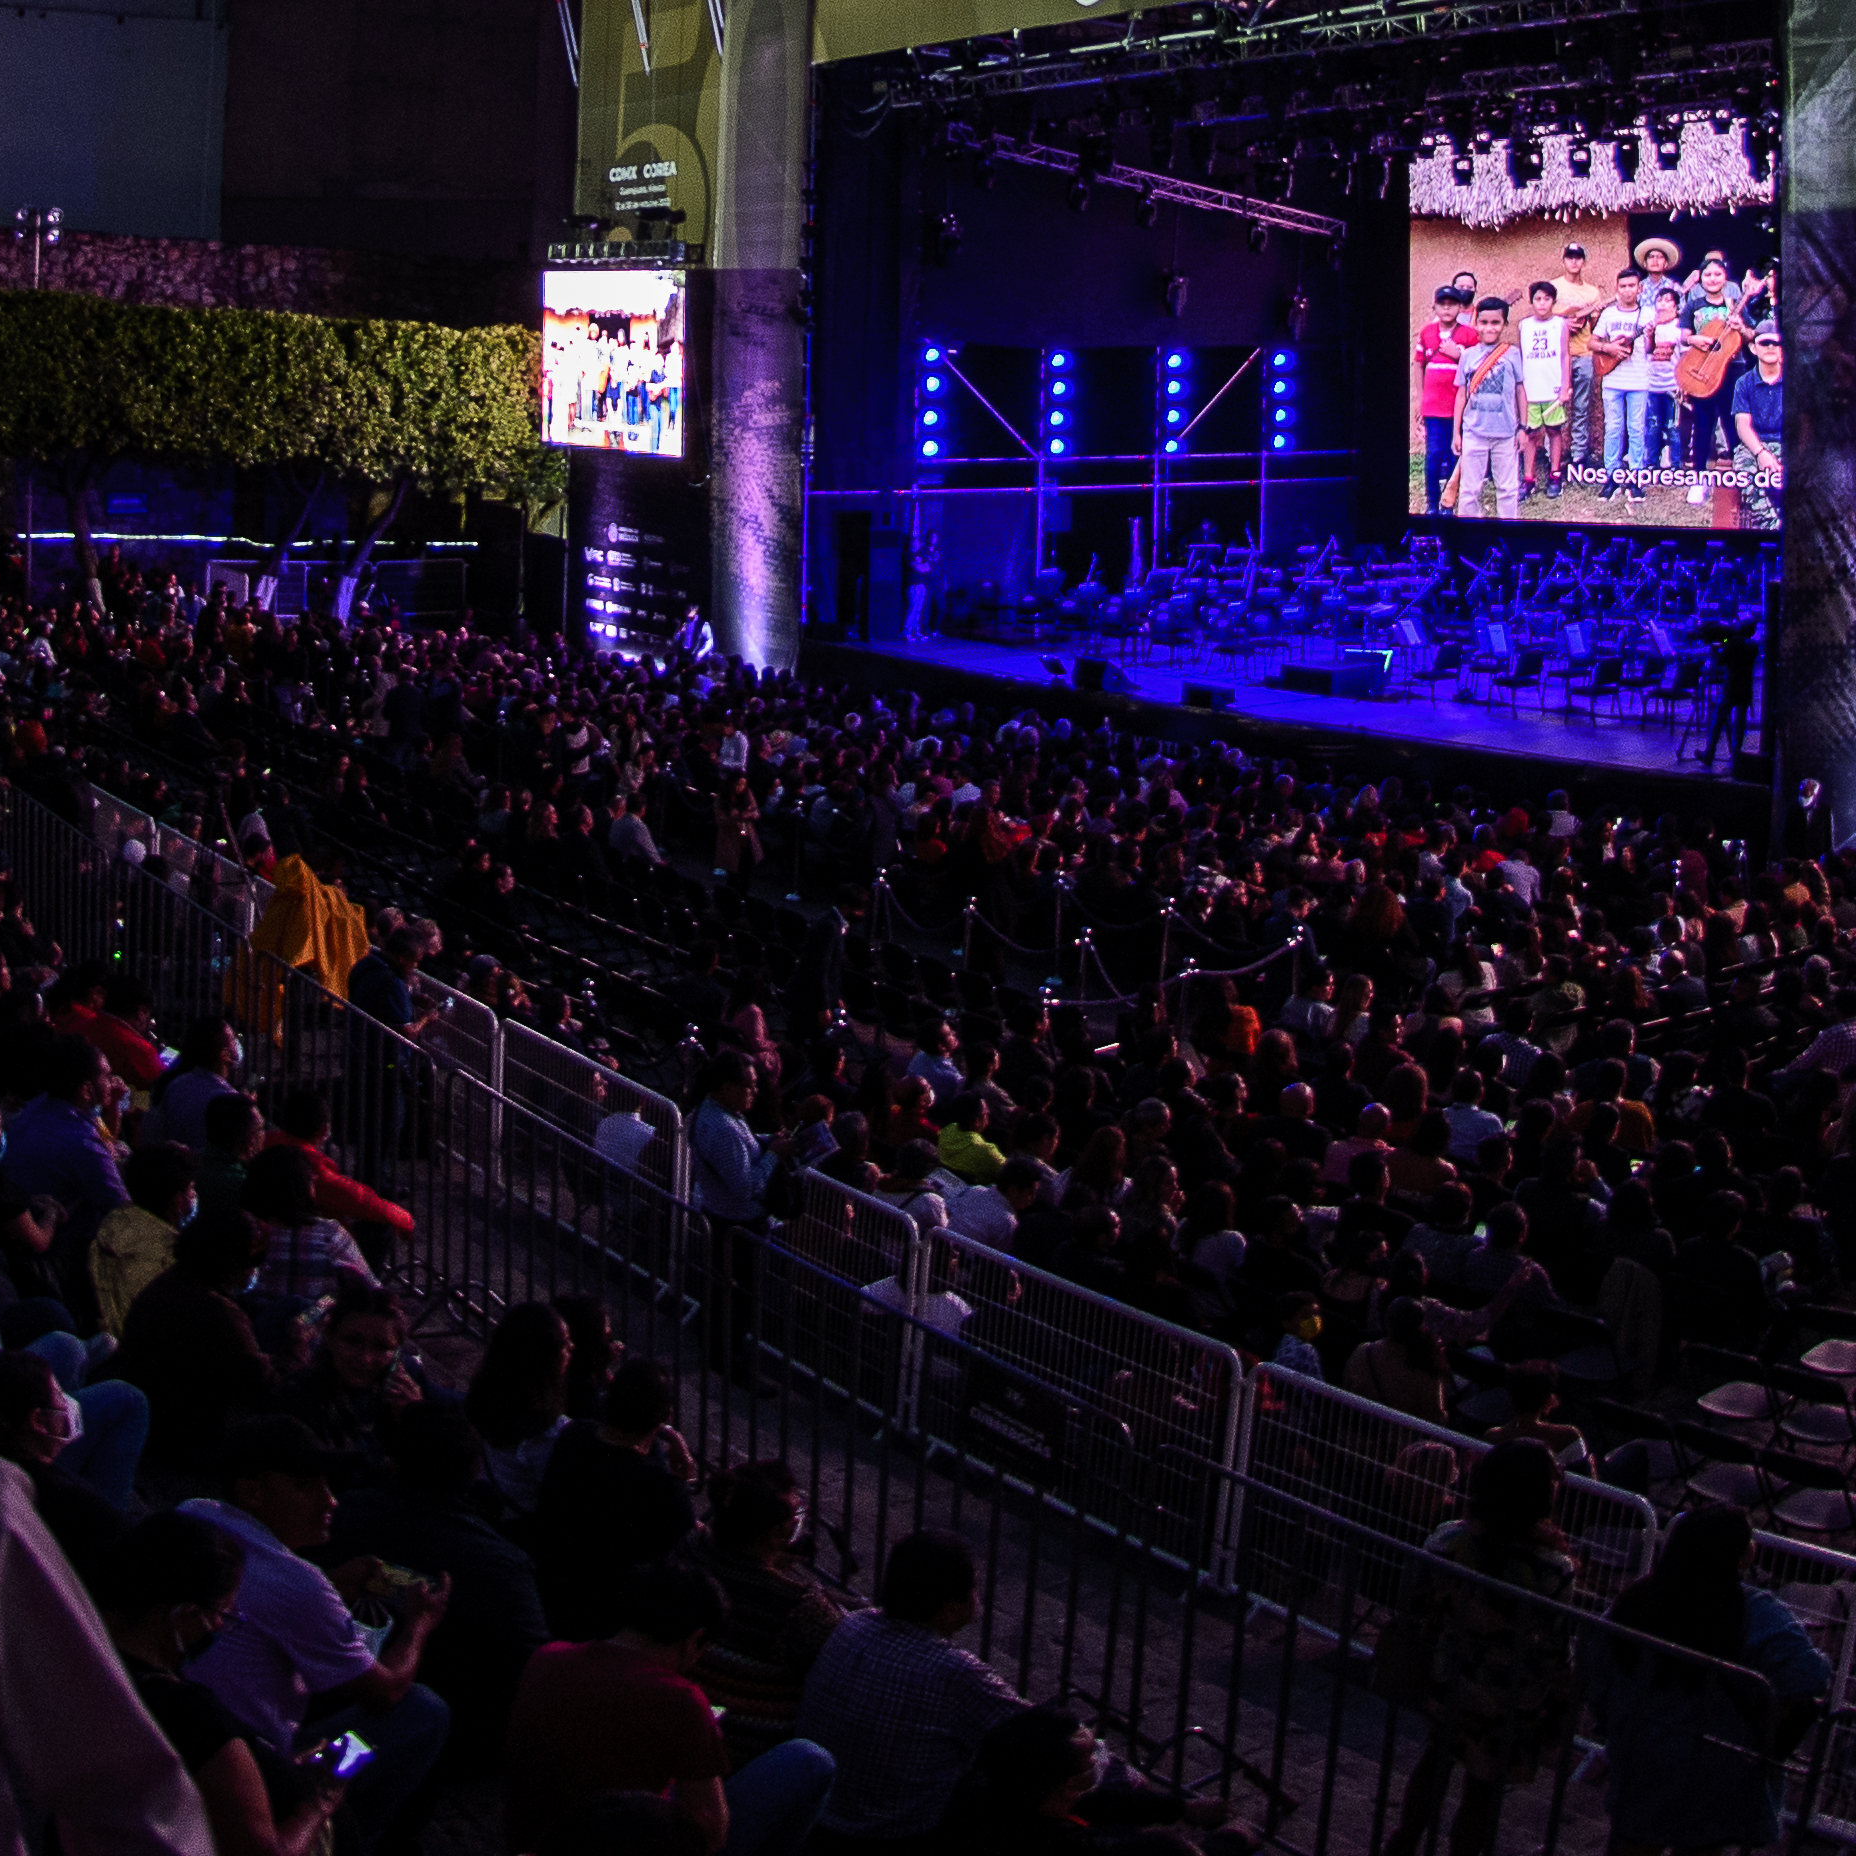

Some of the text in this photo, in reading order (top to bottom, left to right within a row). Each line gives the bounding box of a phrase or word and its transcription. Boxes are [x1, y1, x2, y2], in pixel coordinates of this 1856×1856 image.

[1533, 329, 1547, 337] AIR
[1532, 337, 1548, 351] 23
[1567, 464, 1784, 489] Nos expresamos de
